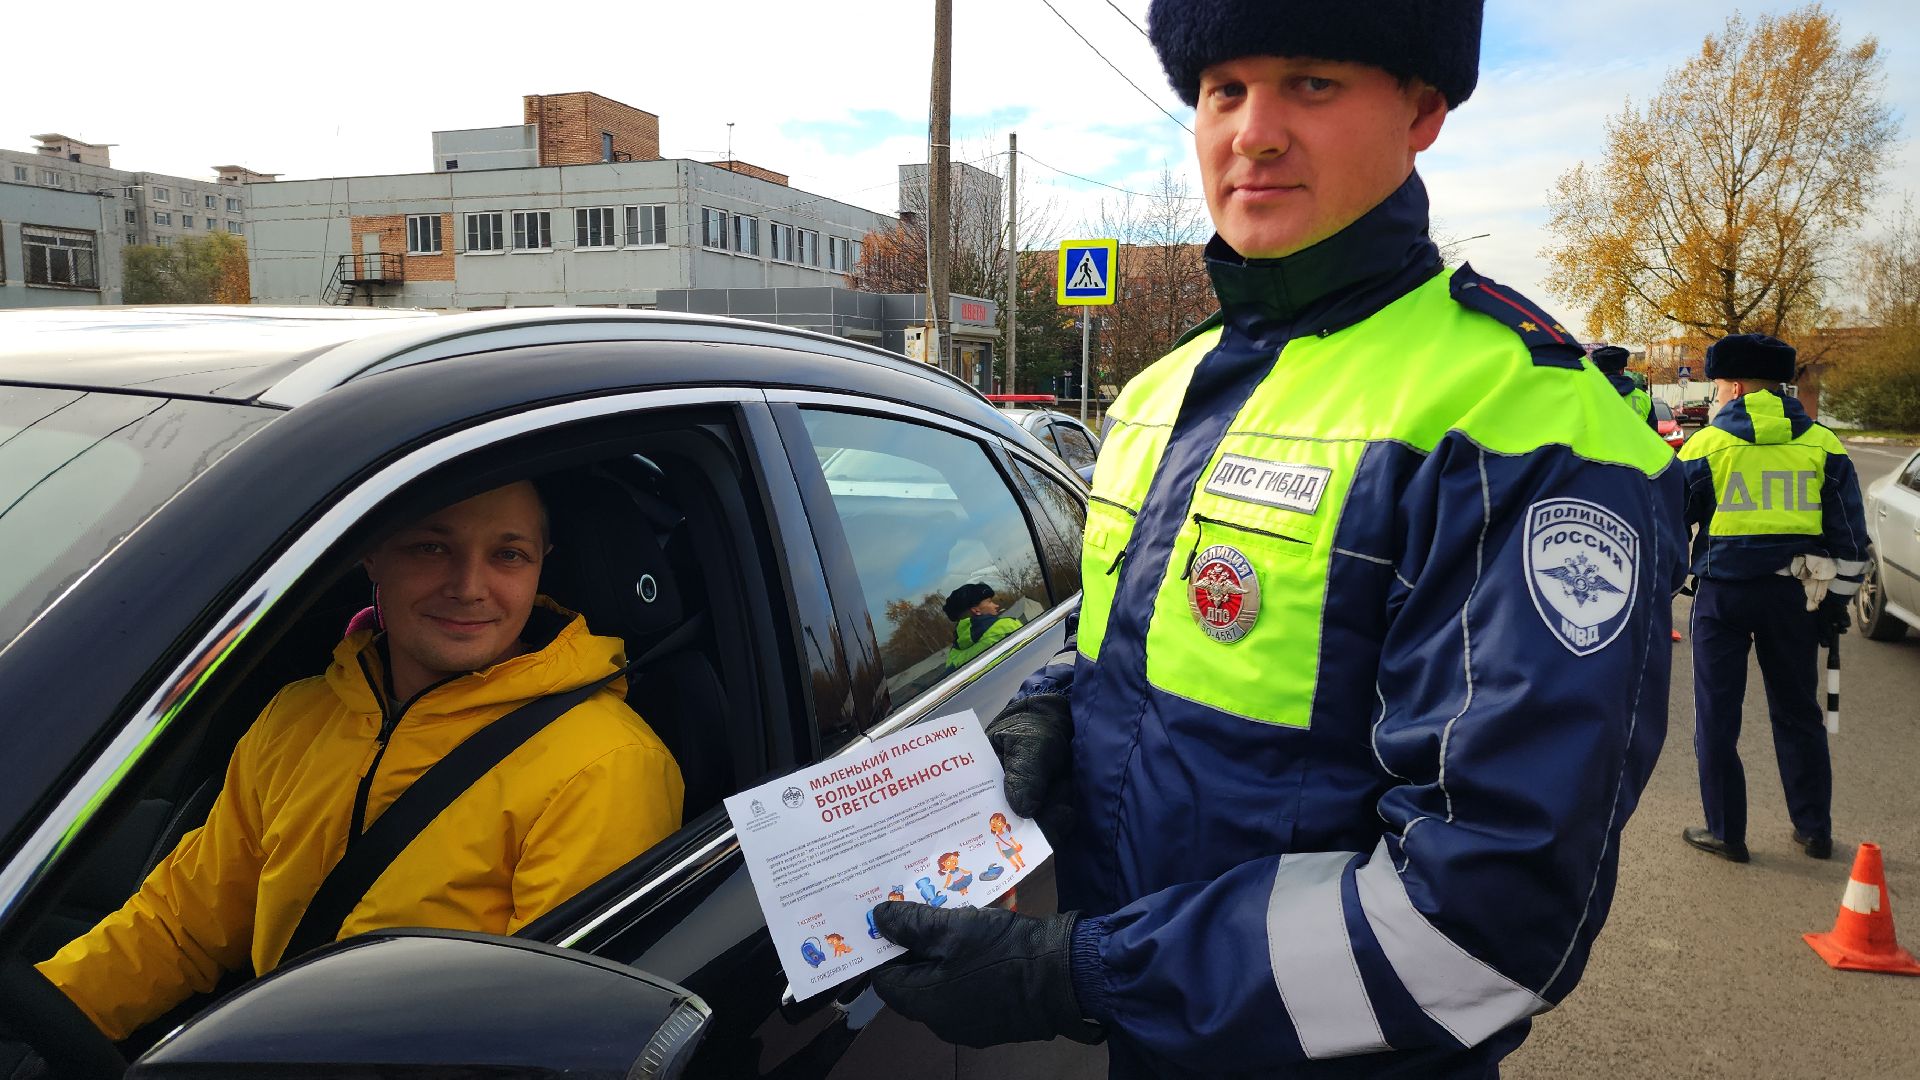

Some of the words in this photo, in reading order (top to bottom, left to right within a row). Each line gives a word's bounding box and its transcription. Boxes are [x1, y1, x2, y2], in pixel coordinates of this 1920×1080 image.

[1214, 463, 1256, 486] ДПС
[1255, 470, 1320, 502] ГИБДД
[1717, 471, 1822, 512] ДПС
[1538, 507, 1631, 549] ПОЛИЦИЯ
[1194, 546, 1250, 577] ПОЛИЦИЯ
[1543, 530, 1623, 573] РОССИЯ
[1206, 606, 1230, 623] ДПС
[1561, 618, 1600, 647] МВД
[810, 750, 889, 790] МАЛЕНЬКИЙ
[891, 727, 957, 757] ПАССАЖИР
[815, 768, 893, 808] БОЛЬШАЯ
[822, 753, 974, 822] ОТВЕТСТВЕННОСТЬ!
